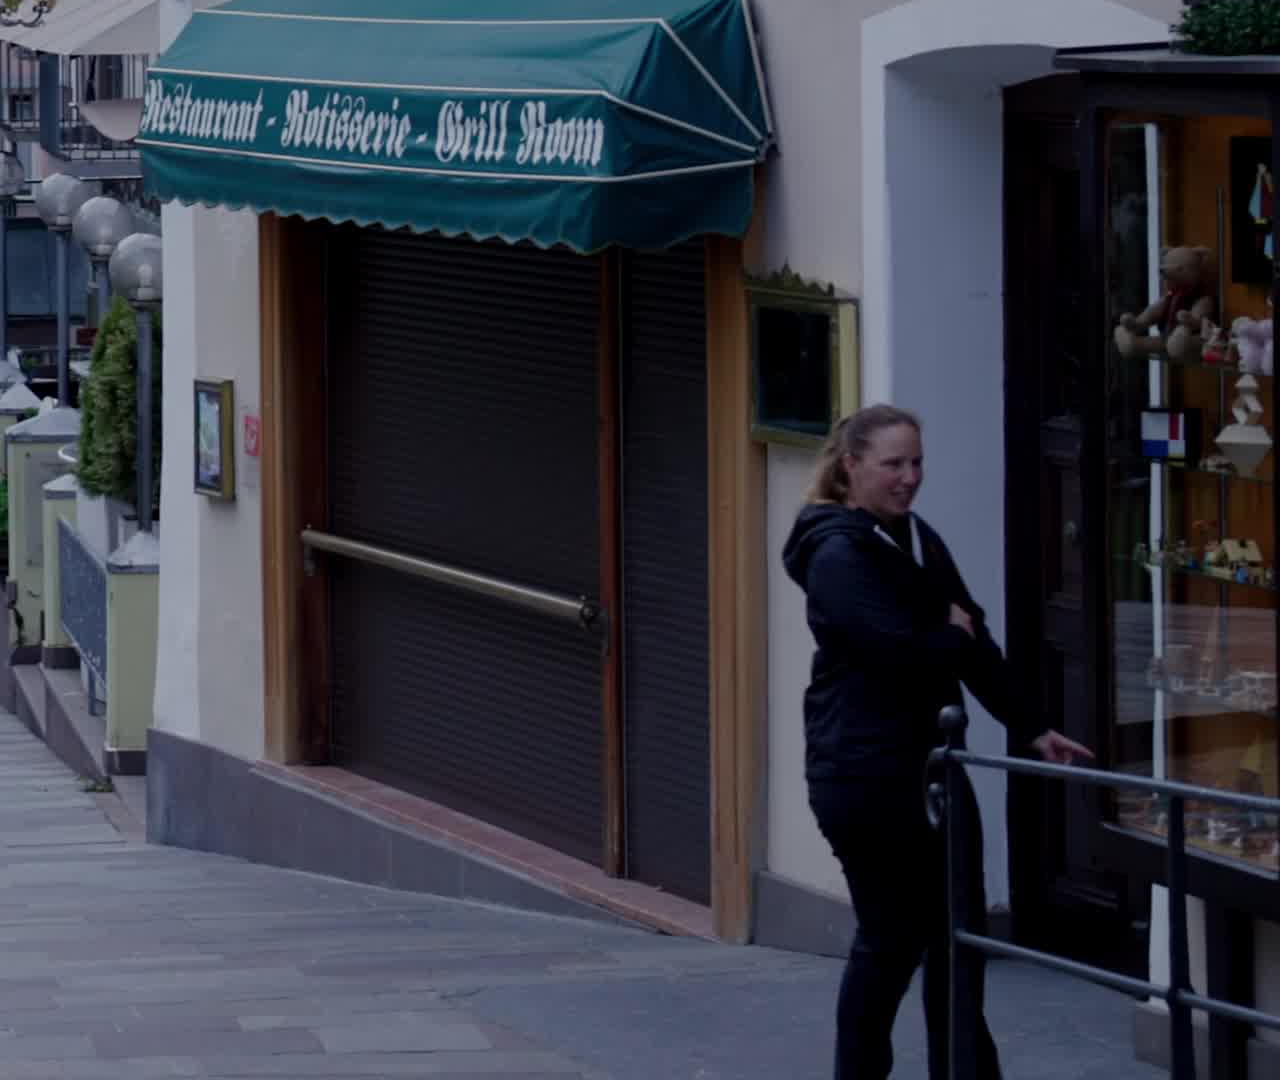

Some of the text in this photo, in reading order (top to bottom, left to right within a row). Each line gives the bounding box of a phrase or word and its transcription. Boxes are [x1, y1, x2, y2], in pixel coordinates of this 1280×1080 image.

[141, 78, 264, 144] Restaurant
[280, 88, 412, 158] Rotisserie
[434, 99, 511, 163] Grill
[515, 99, 604, 167] Room
